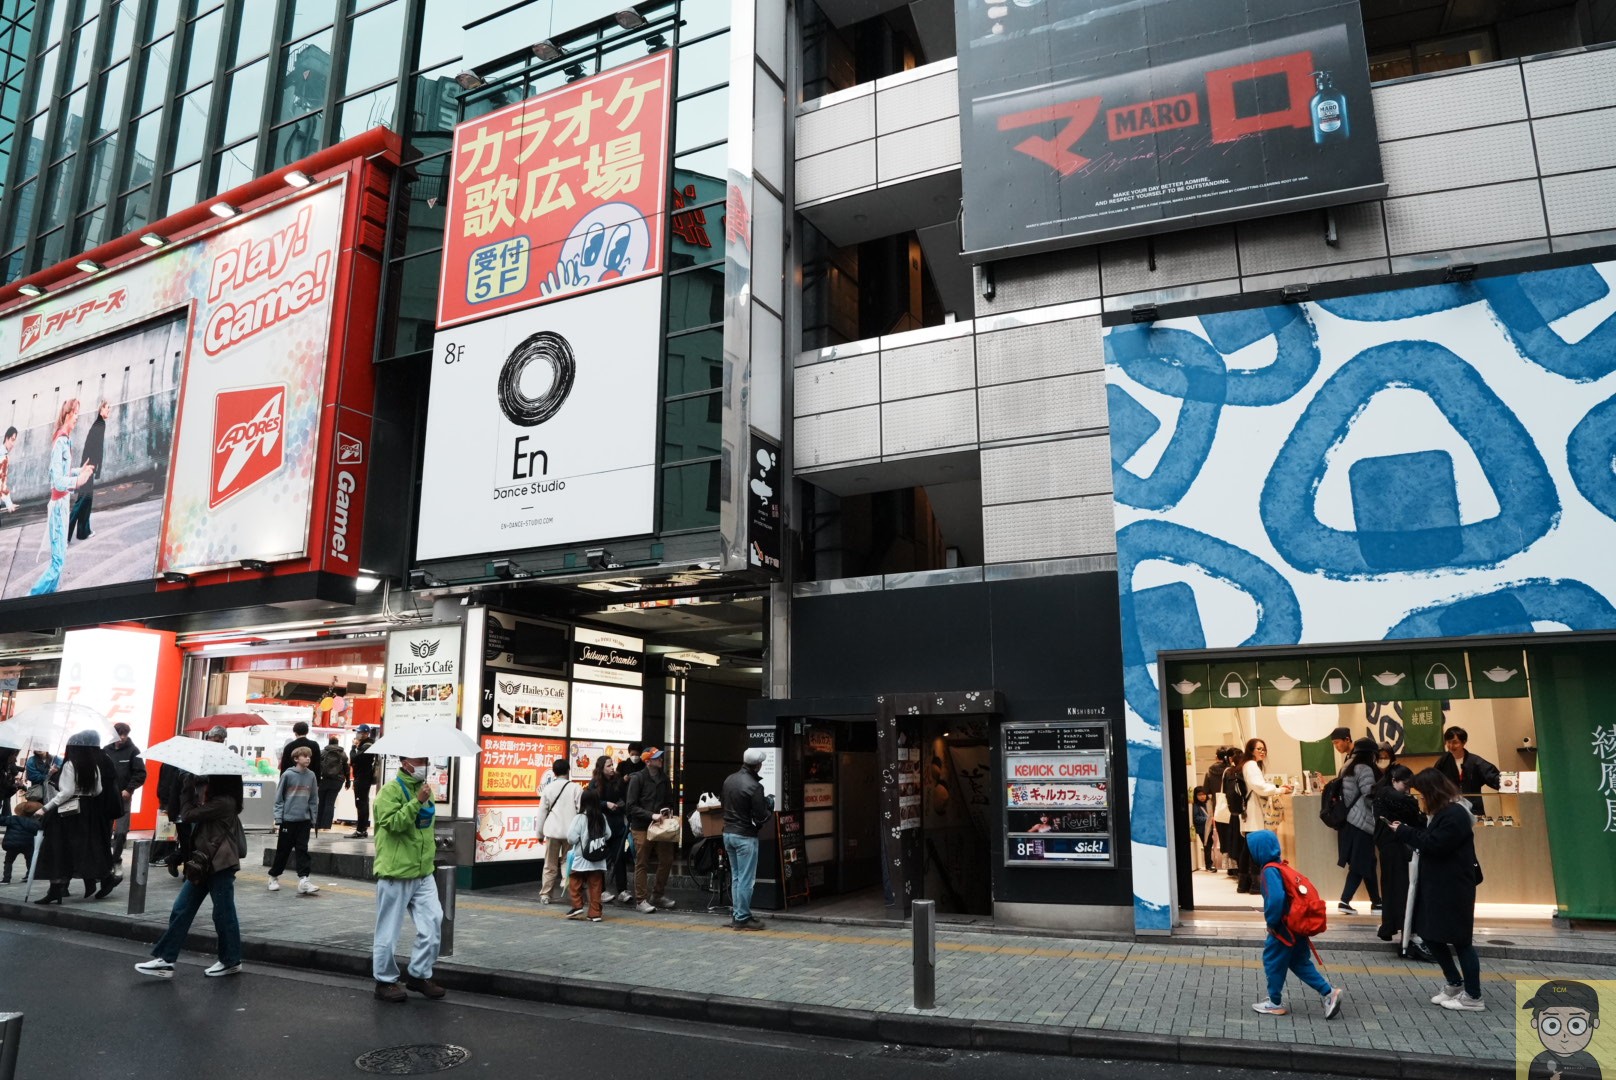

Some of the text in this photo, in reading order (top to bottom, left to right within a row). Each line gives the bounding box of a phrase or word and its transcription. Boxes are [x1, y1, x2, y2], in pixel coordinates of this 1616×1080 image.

[457, 77, 662, 184] カラオケ
[1114, 98, 1192, 135] MARO
[463, 132, 645, 238] 歌広場
[1108, 195, 1135, 205] RESPECT
[1136, 190, 1167, 199] YOURSELF
[1112, 190, 1130, 199] MAKE
[1131, 187, 1147, 195] YOUR
[1161, 181, 1184, 190] BETTER
[207, 204, 313, 304] Play!
[474, 243, 523, 276] 受付
[474, 267, 518, 299] 5F
[44, 289, 127, 336] アドアーズ
[202, 250, 332, 358] Game!
[444, 343, 465, 365] 8F
[217, 416, 281, 452] ADORES
[512, 435, 548, 480] En
[493, 480, 566, 500] Dance Studio
[332, 470, 356, 563] Game!
[432, 660, 454, 673] Café
[550, 687, 565, 698] Café
[511, 774, 532, 790] OK!
[1030, 787, 1080, 801] ギャルカフェ
[1017, 842, 1034, 856] 8F
[1075, 840, 1104, 853] Sick!
